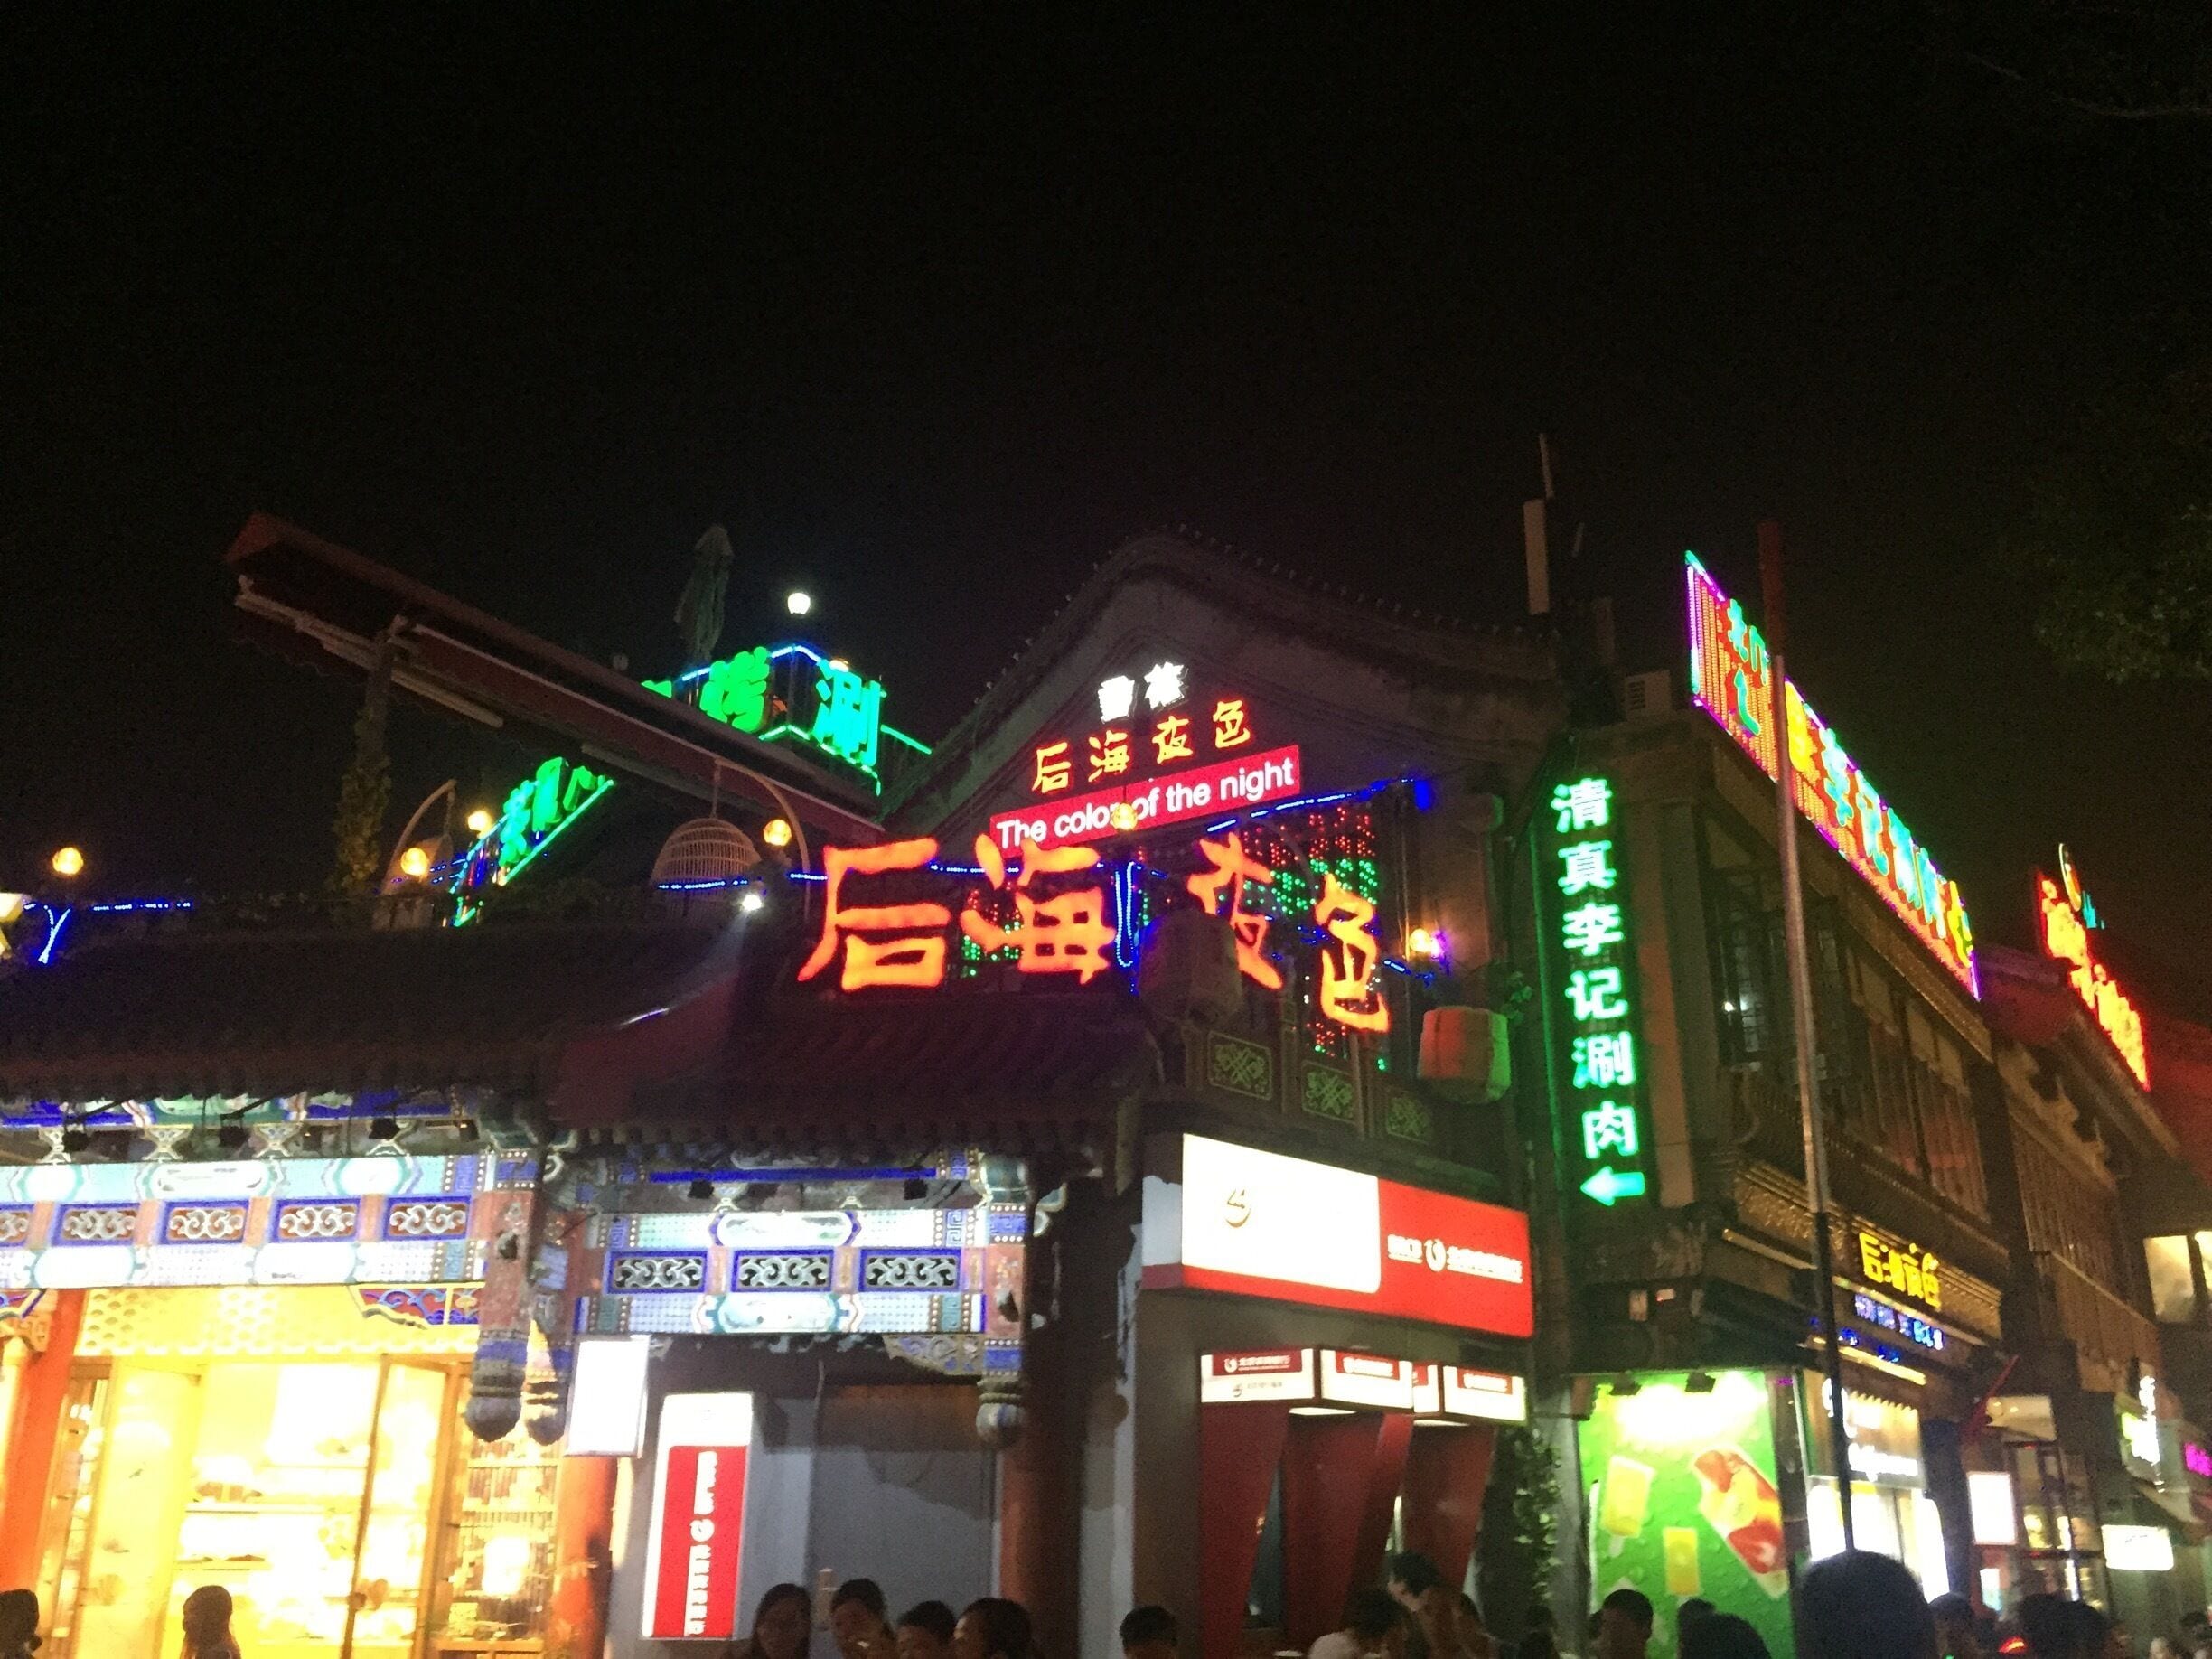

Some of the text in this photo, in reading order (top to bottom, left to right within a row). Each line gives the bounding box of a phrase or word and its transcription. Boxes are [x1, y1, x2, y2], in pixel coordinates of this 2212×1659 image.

[996, 820, 1047, 848] The
[1130, 787, 1161, 820] of
[1166, 783, 1212, 812] the
[1220, 757, 1295, 801] night
[1032, 699, 1251, 793] 后海夜色
[798, 834, 1390, 1032] 后海夜色
[1551, 776, 1640, 1160] 清真李记涮肉
